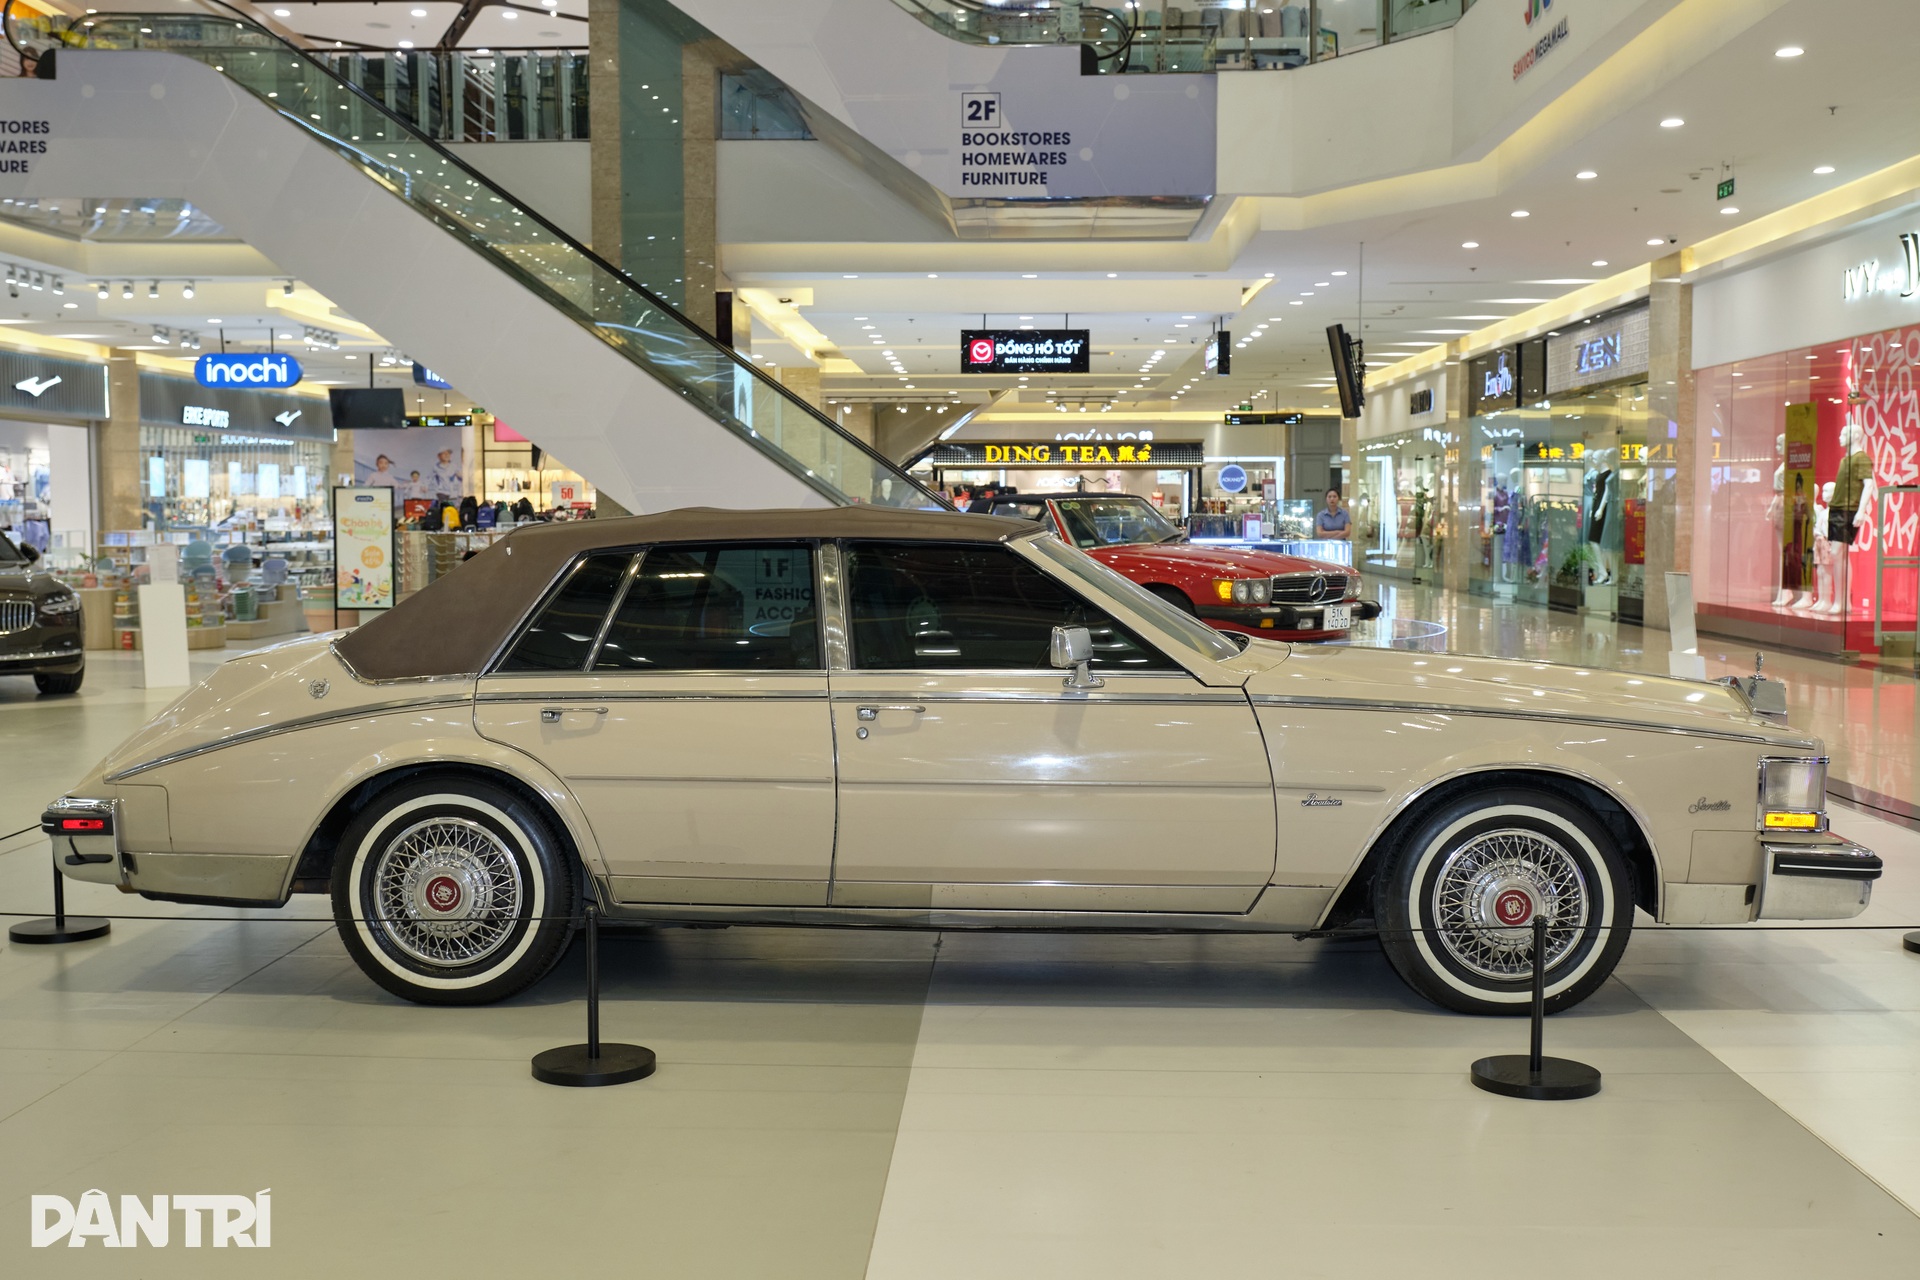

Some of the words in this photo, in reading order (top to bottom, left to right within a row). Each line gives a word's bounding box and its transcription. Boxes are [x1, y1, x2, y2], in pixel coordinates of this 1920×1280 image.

[967, 100, 996, 121] 2F
[962, 132, 1071, 146] BOOKSTORES
[962, 152, 1067, 166] HOMEWARES
[962, 172, 1047, 185] FURNITURE
[1844, 259, 1879, 300] IVY
[1575, 332, 1621, 374] ZEN
[206, 356, 288, 383] inochi
[985, 445, 1050, 462] DING
[1060, 446, 1114, 462] TEA
[561, 488, 573, 499] 50
[762, 558, 789, 577] 1F
[1332, 608, 1344, 618] 51K
